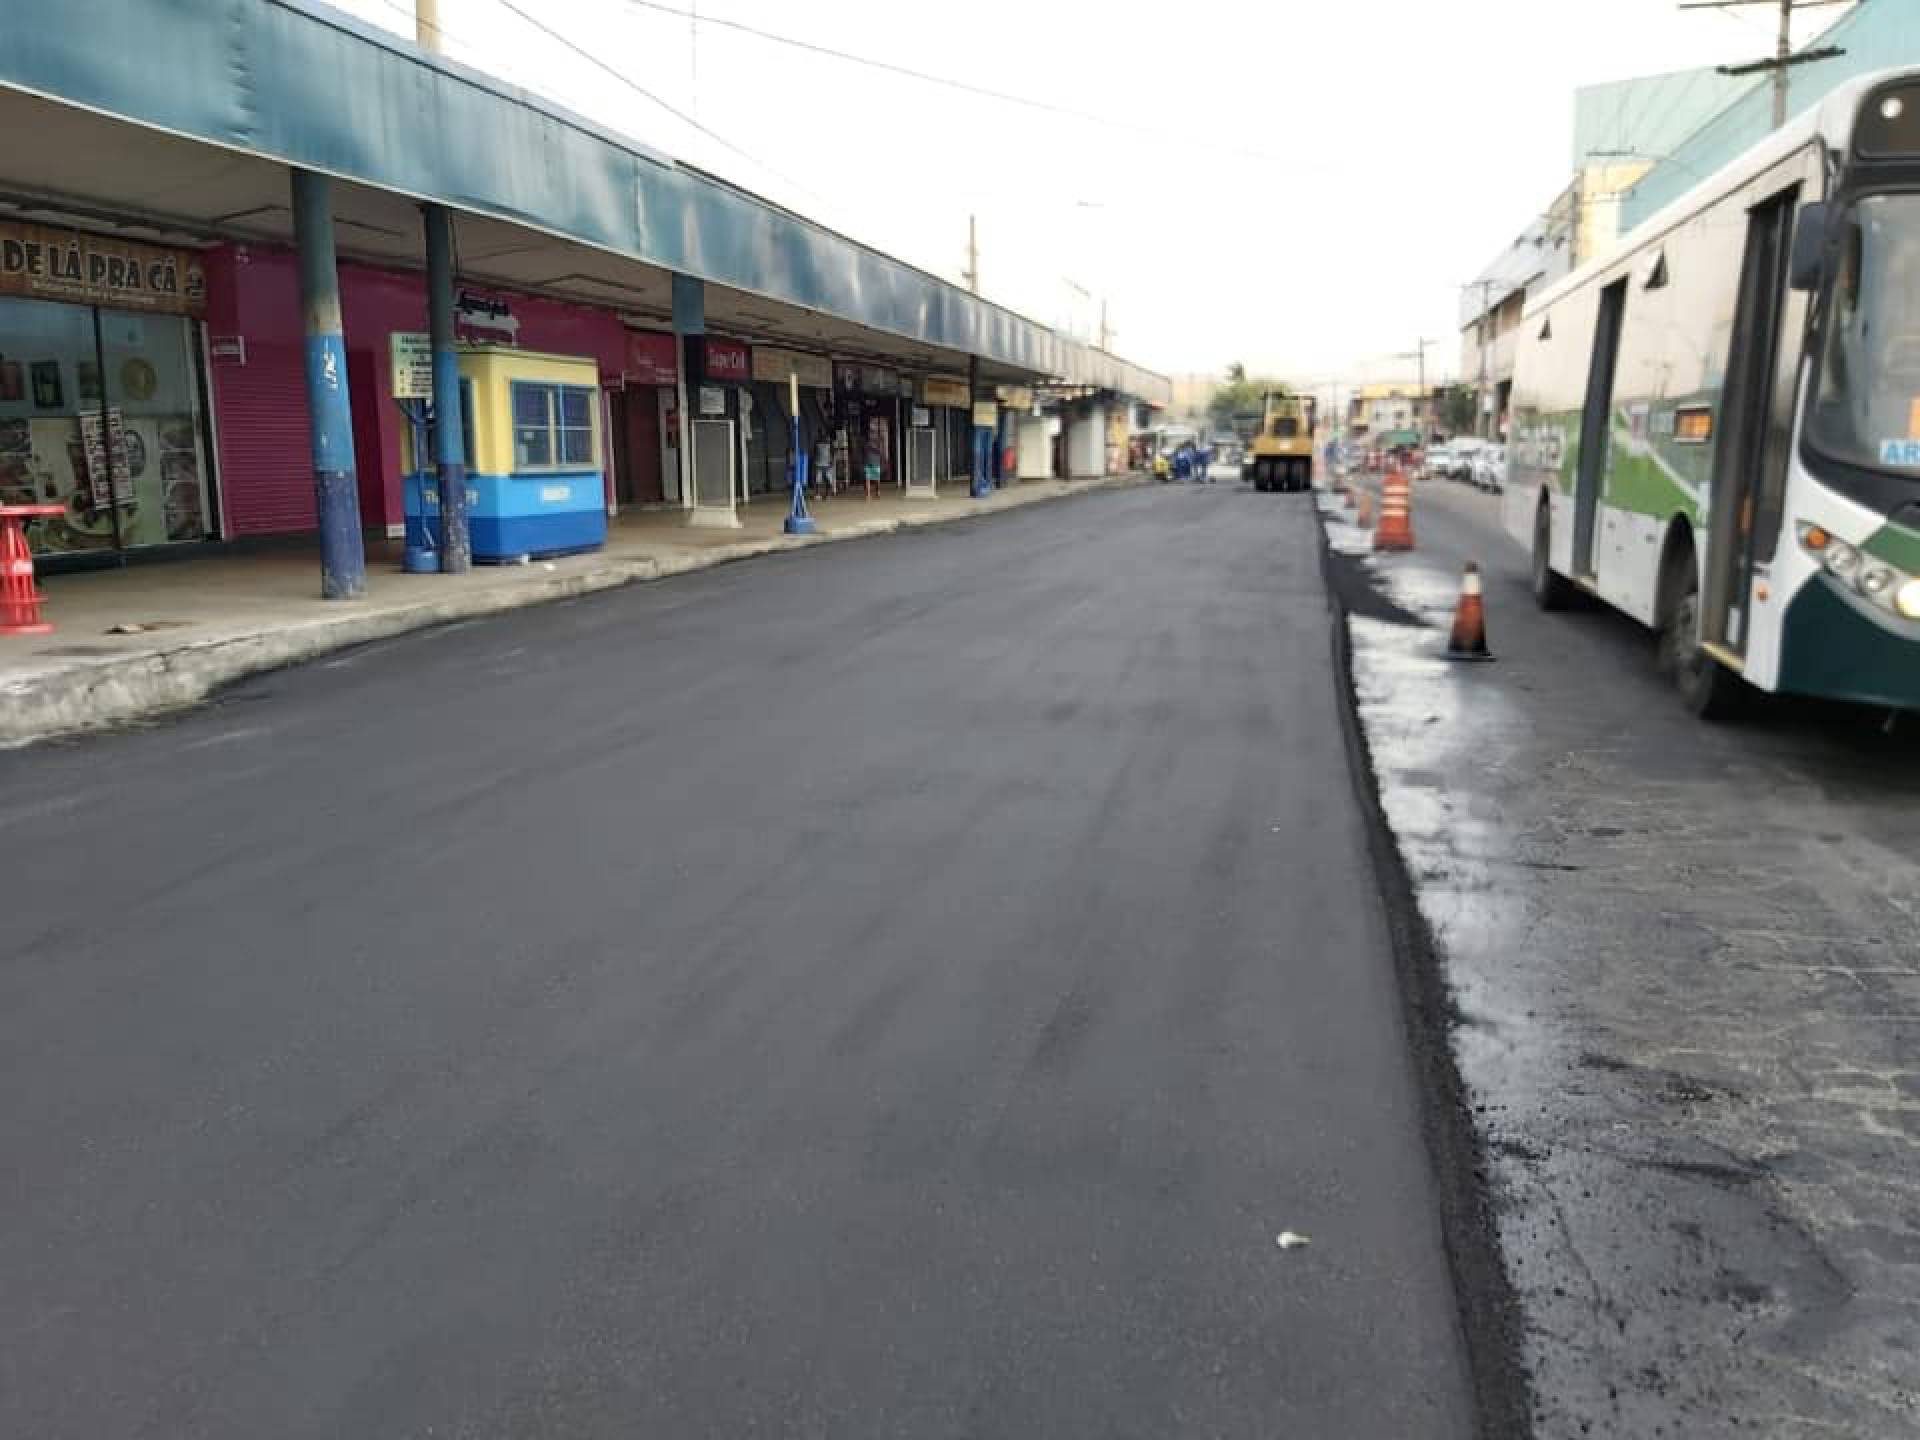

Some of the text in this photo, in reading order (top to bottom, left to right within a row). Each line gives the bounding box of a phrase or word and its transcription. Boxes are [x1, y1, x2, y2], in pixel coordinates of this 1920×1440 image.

[3, 239, 43, 276] DE
[48, 240, 81, 282] LÁ
[87, 253, 143, 291] PRA
